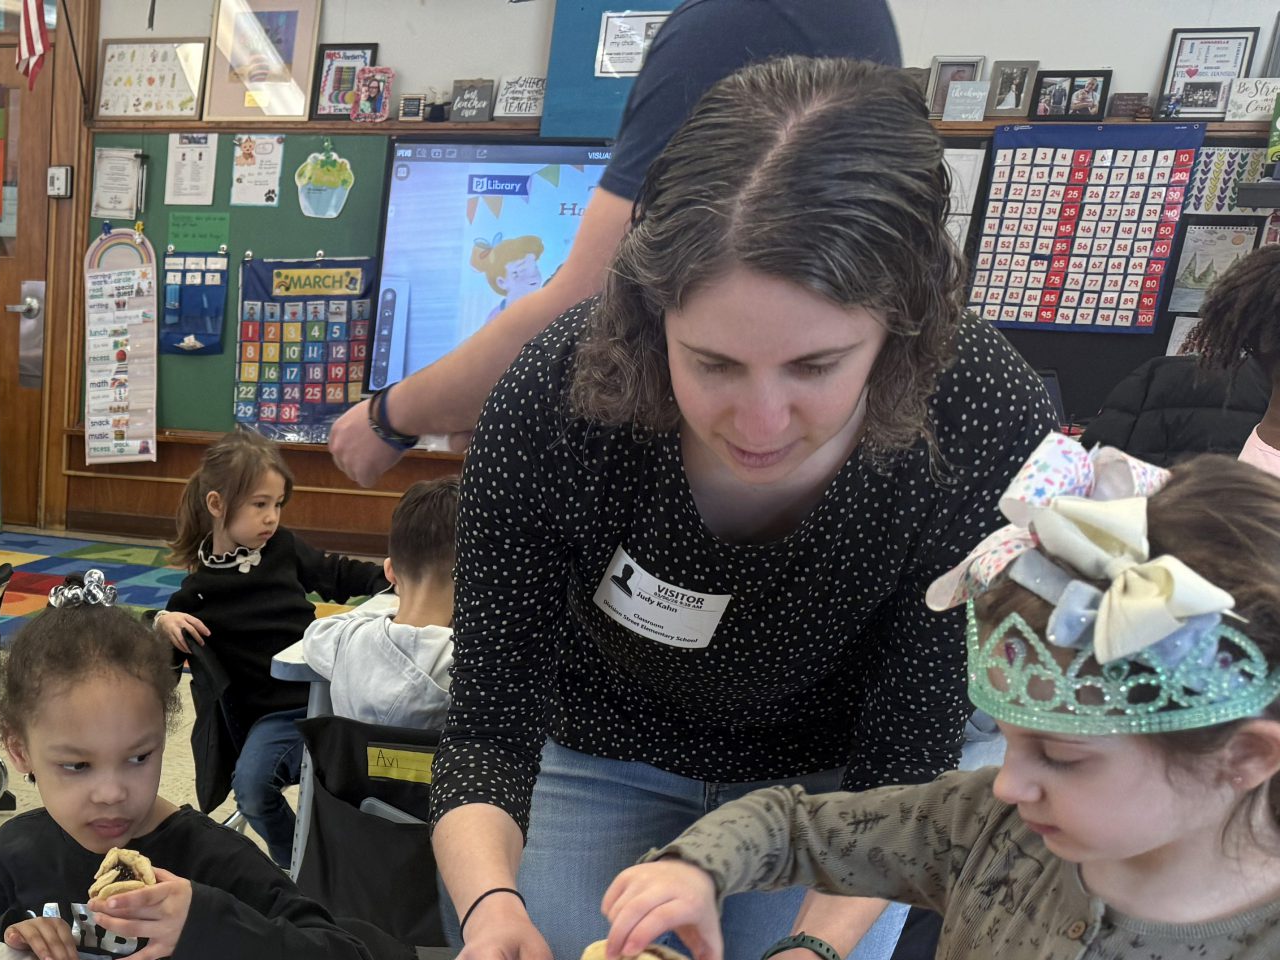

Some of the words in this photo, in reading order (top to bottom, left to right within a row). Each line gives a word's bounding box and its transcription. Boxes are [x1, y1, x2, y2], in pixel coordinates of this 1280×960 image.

[453, 97, 487, 110] teacher
[587, 151, 611, 160] VISUA
[1180, 154, 1189, 162] 10
[488, 180, 522, 192] Library
[289, 276, 343, 289] MARCH
[116, 290, 133, 298] guest
[89, 328, 107, 336] lunch
[248, 325, 252, 337] 1
[268, 327, 275, 338] 2
[288, 327, 295, 338] 3
[311, 326, 320, 338] 4
[332, 326, 340, 337] 5
[355, 326, 363, 335] 6
[246, 346, 254, 358] 8
[267, 347, 275, 358] 9
[286, 347, 298, 358] 10
[308, 347, 318, 358] 11
[332, 347, 344, 358] 12
[353, 345, 366, 357] 13
[244, 366, 255, 377] 15
[265, 367, 276, 378] 16
[286, 368, 298, 379] 17
[309, 367, 321, 379] 18
[331, 366, 343, 377] 19
[350, 366, 363, 377] 20
[90, 380, 108, 388] math
[239, 386, 255, 398] 22
[262, 388, 277, 399] 23
[284, 389, 299, 400] 24
[305, 388, 320, 399] 25
[327, 388, 342, 399] 26
[238, 404, 252, 413] 29
[260, 406, 276, 417] 30
[282, 406, 294, 417] 31
[657, 584, 705, 606] VISITOR
[636, 591, 656, 605] Judy
[657, 601, 678, 613] Kahn
[603, 599, 622, 616] Division
[623, 614, 640, 628] Street
[640, 624, 675, 640] Elementary
[633, 613, 664, 630] Classroom
[377, 750, 398, 768] Avi
